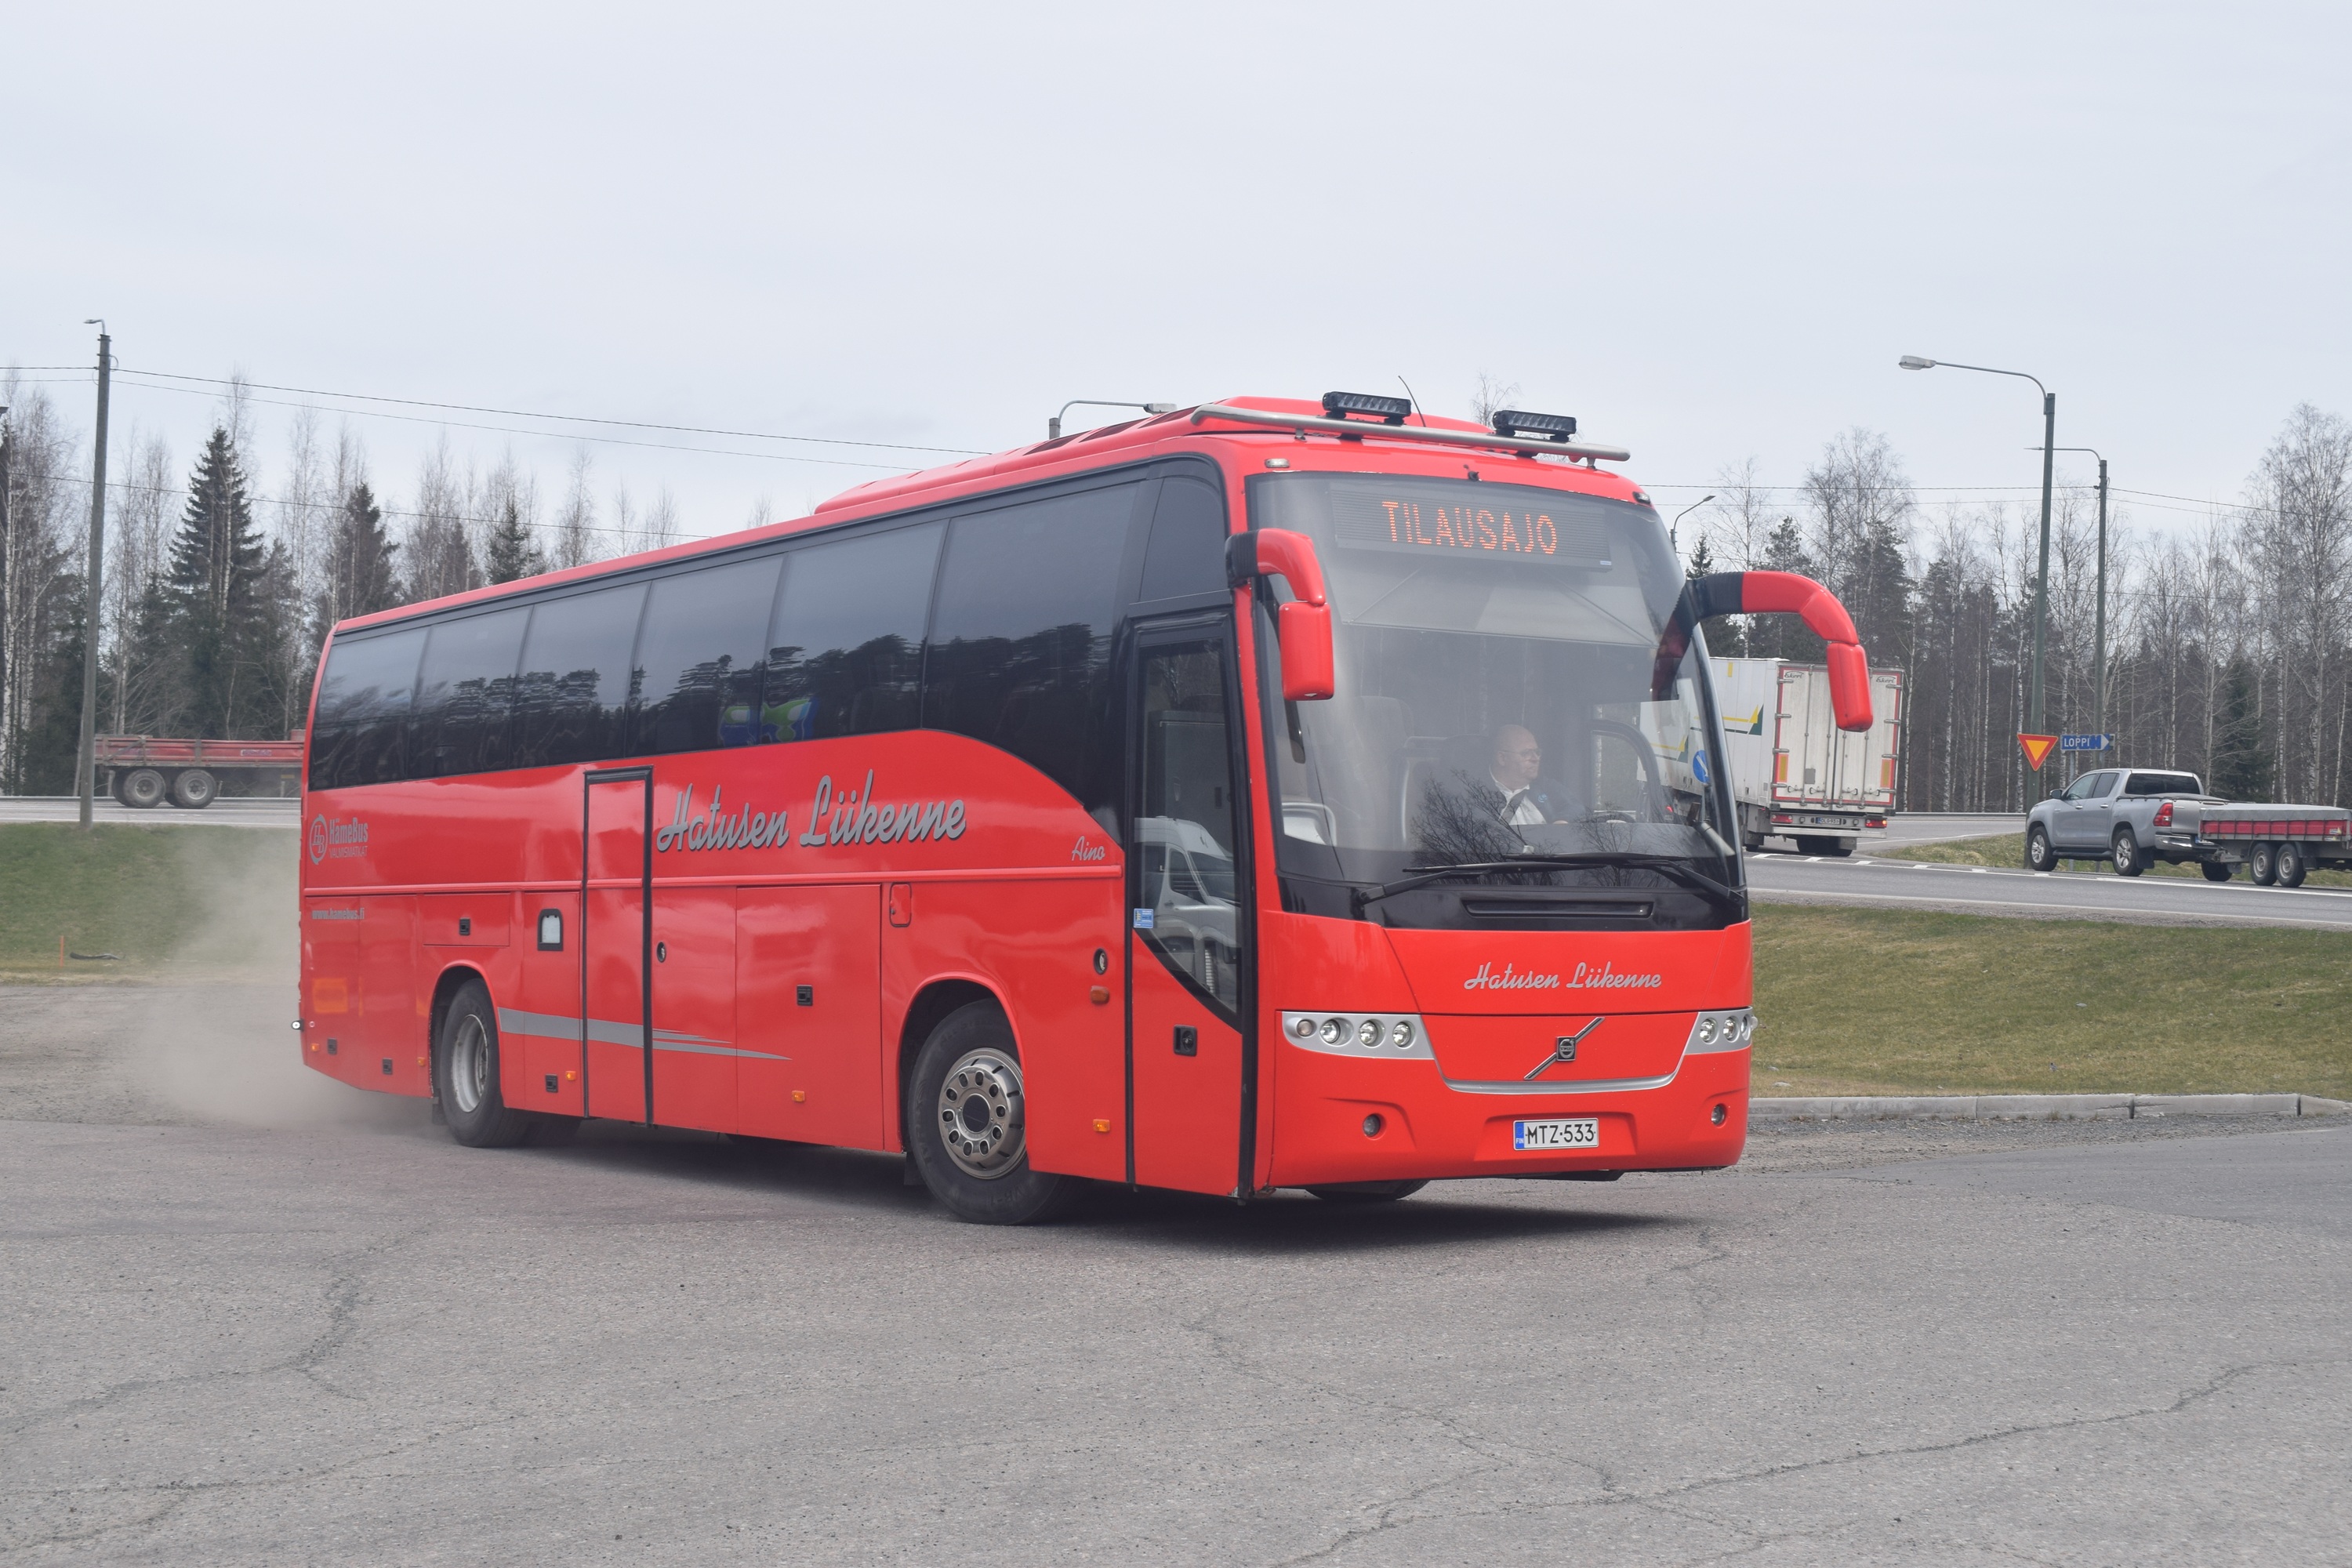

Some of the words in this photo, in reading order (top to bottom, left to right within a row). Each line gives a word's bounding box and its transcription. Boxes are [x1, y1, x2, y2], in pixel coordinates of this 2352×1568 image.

[1381, 501, 1557, 554] TILAUSAJO
[2064, 738, 2090, 747] LOPPI
[657, 783, 789, 851] Hatusen
[800, 768, 967, 847] Liikenne
[329, 817, 368, 844] HämeBus
[1071, 836, 1106, 862] Aino
[1464, 961, 1559, 989] Hatusen
[1566, 961, 1661, 989] Liikenne
[1527, 1123, 1594, 1144] MTZ-533
